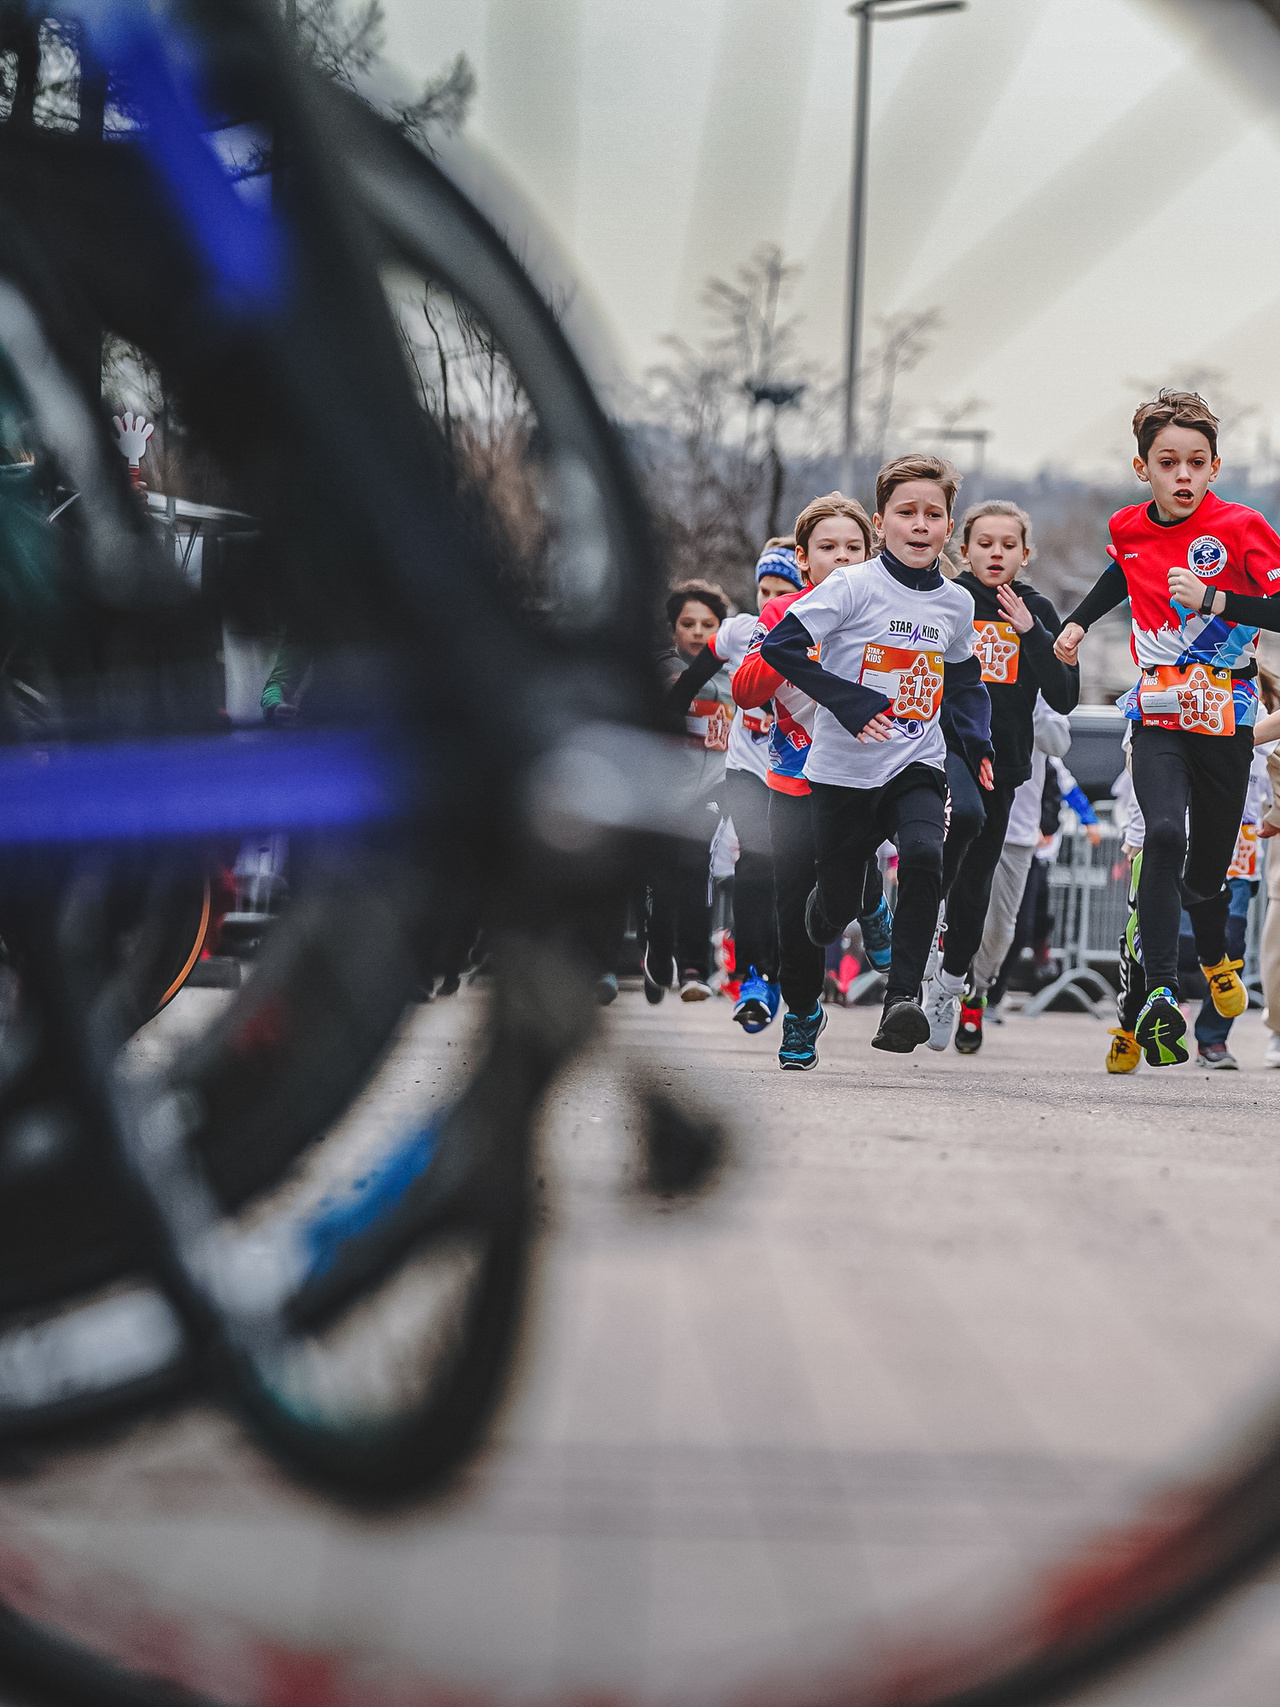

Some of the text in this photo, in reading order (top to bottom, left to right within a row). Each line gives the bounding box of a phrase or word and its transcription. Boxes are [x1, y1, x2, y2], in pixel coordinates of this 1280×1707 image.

[1193, 566, 1221, 576] ТРИАТЛОН
[889, 620, 940, 640] STAR KIDS
[866, 646, 881, 655] STAR
[982, 642, 995, 664] 1
[865, 653, 882, 664] KIDS
[912, 674, 923, 699] 1
[1142, 677, 1158, 686] KIDS
[1191, 688, 1205, 713] 1
